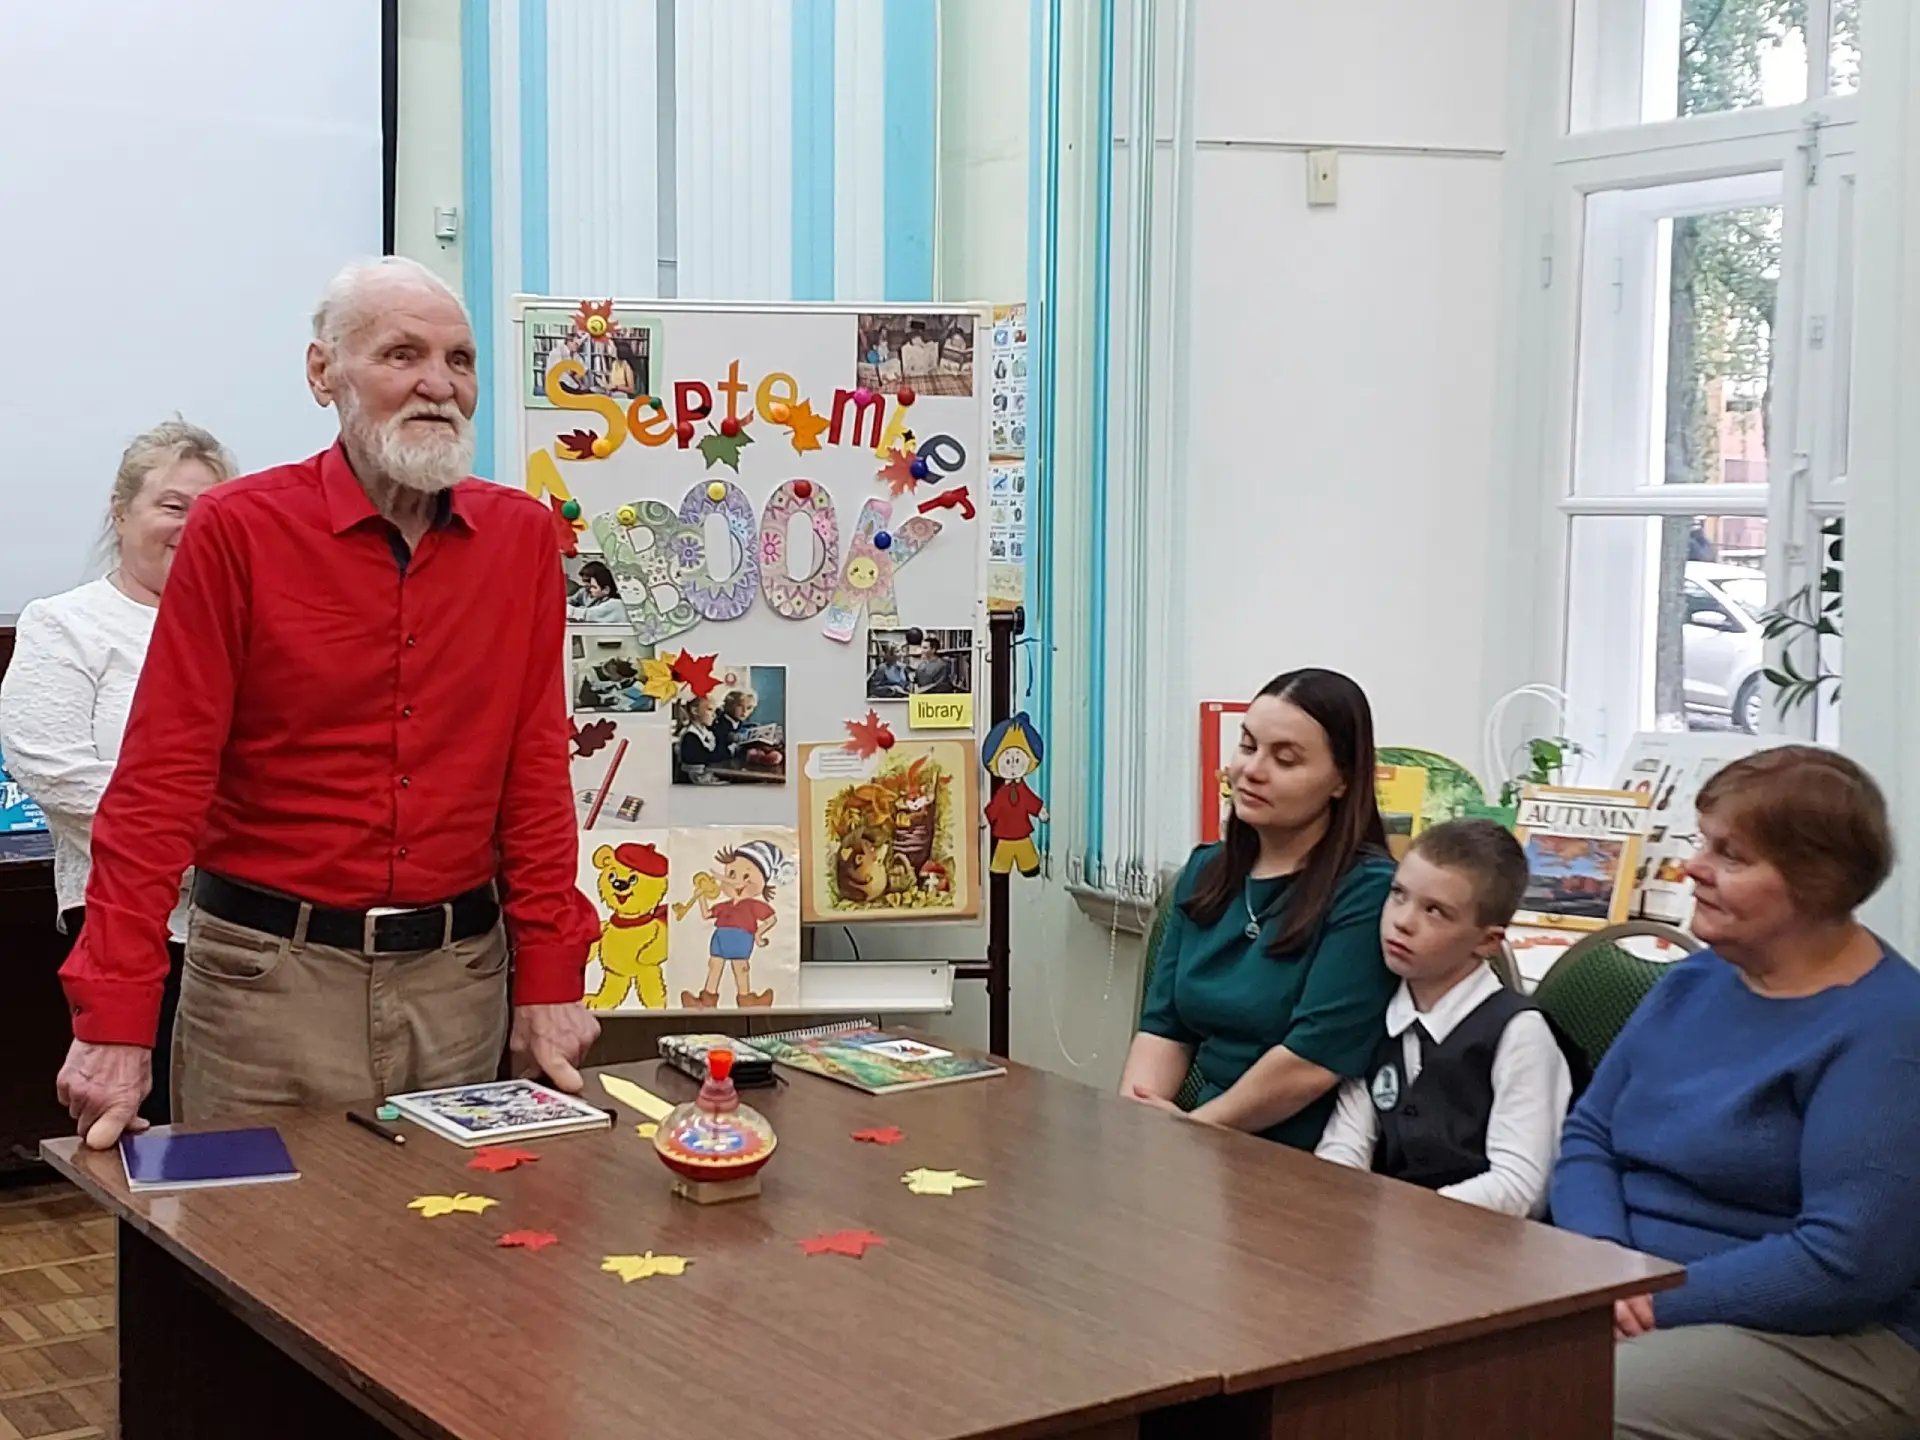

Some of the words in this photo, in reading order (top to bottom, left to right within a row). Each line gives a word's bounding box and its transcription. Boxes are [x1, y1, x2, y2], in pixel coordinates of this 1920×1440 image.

[592, 479, 943, 646] BOOK
[917, 702, 964, 721] library
[1526, 803, 1640, 829] AUTUMN
